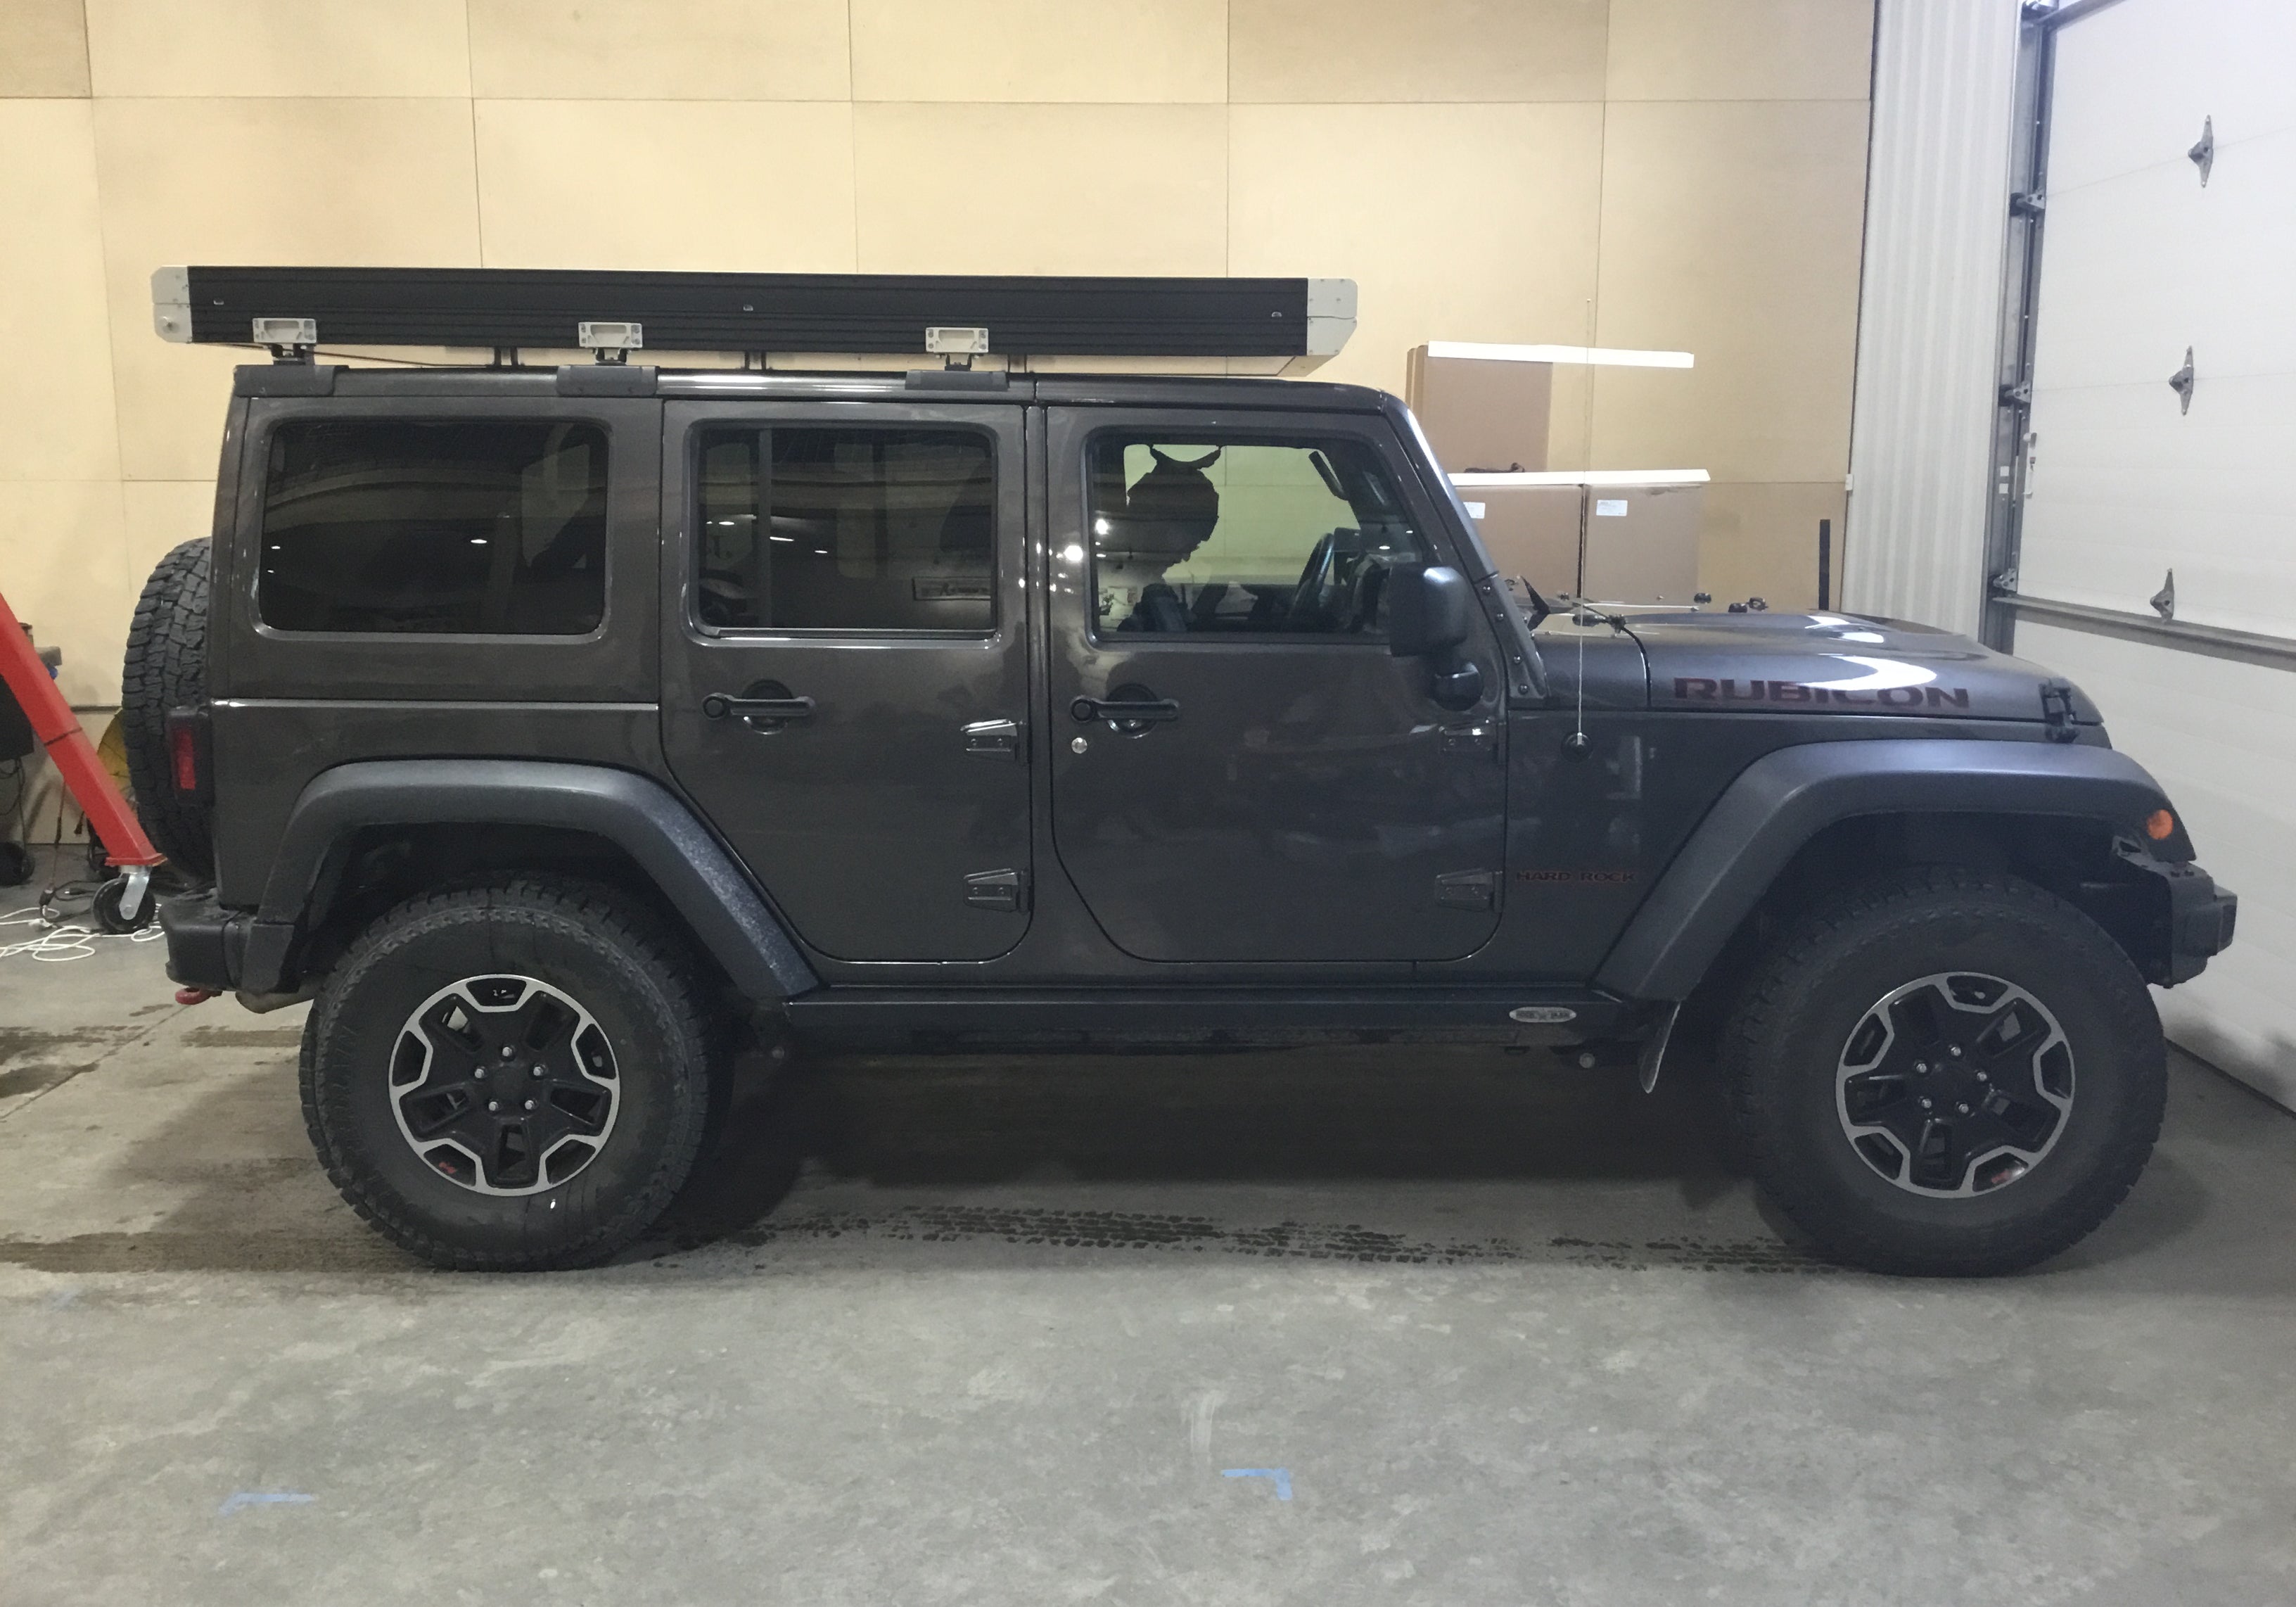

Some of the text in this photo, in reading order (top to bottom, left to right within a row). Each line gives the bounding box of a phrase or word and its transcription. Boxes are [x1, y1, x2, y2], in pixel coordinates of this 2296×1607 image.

[1674, 677, 1970, 708] RUBICON
[1516, 871, 1635, 882] HARD ROCK
